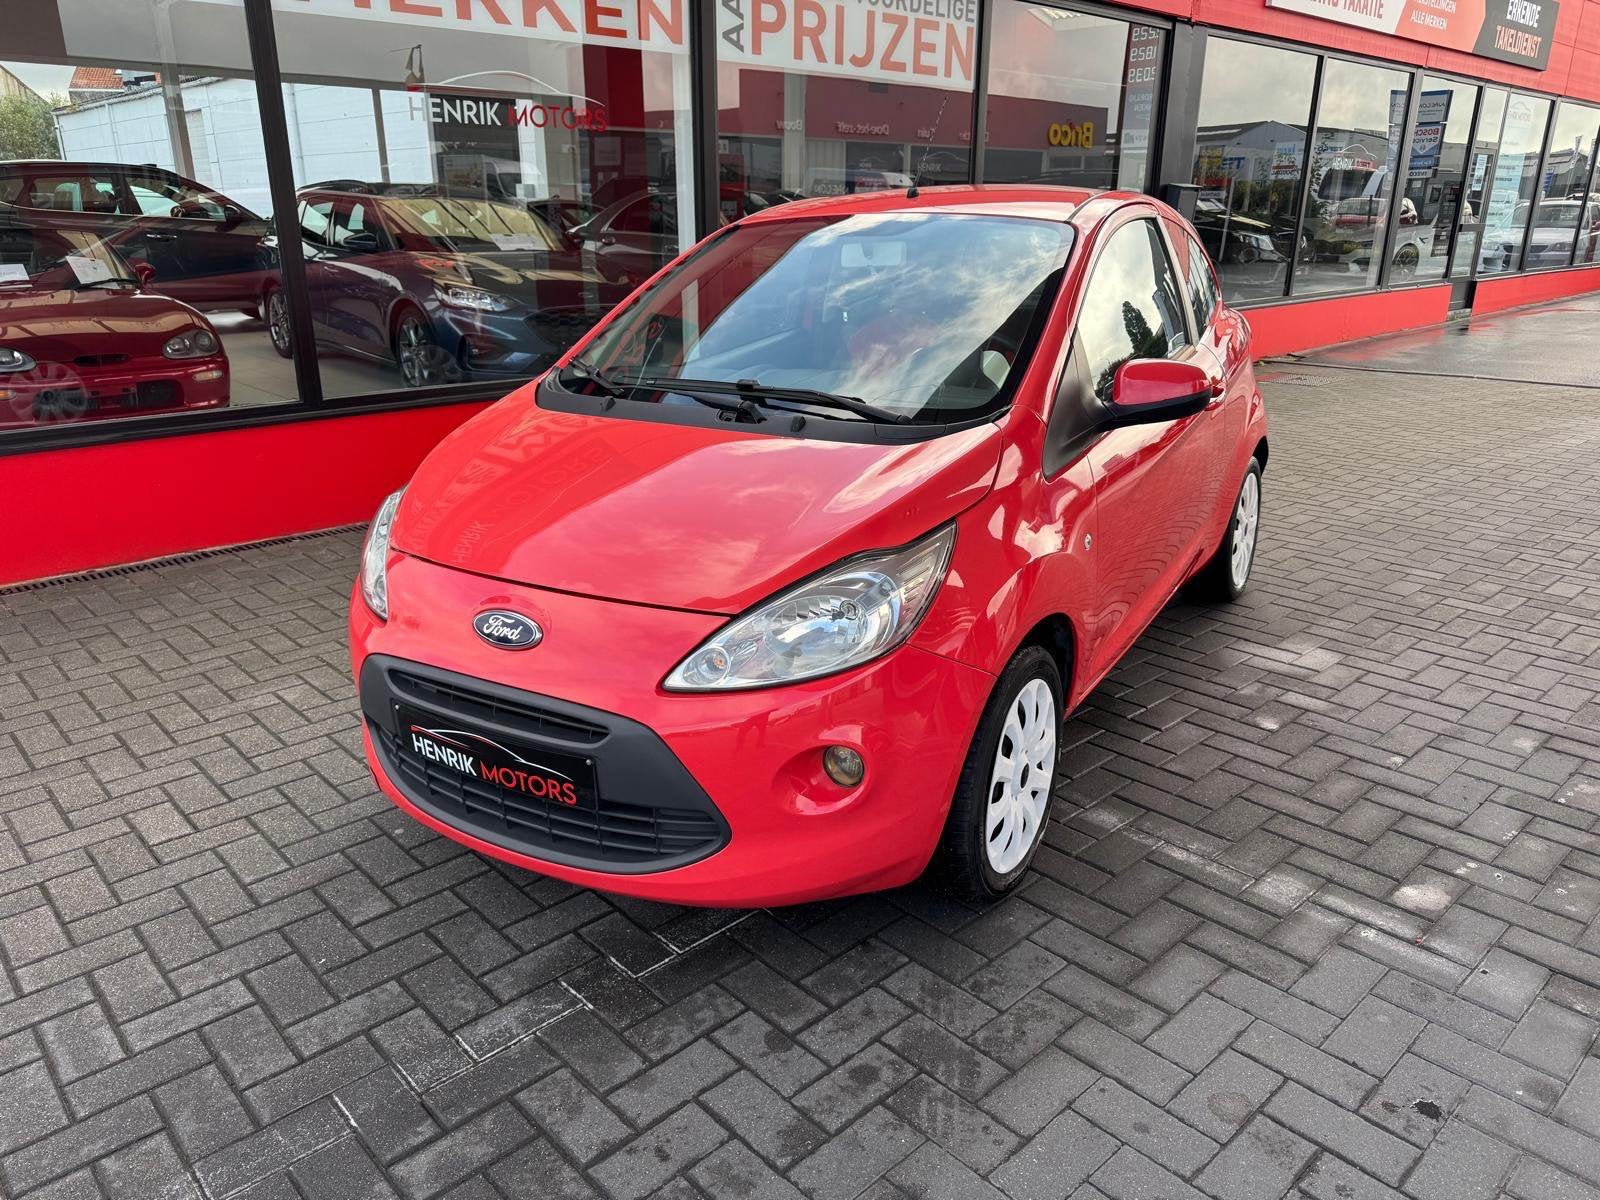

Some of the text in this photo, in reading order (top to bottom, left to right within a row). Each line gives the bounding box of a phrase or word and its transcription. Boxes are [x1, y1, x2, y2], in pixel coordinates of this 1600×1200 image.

[1411, 10, 1448, 31] ALLE MERKEN
[1506, 0, 1542, 28] ERKENDE
[751, 0, 974, 81] PRIJZEN
[1494, 25, 1543, 58] TAKELDIENST
[409, 96, 609, 132] HENRIK MOTORS
[483, 614, 524, 641] Ford
[411, 733, 577, 805] HENRIK MOTORS
